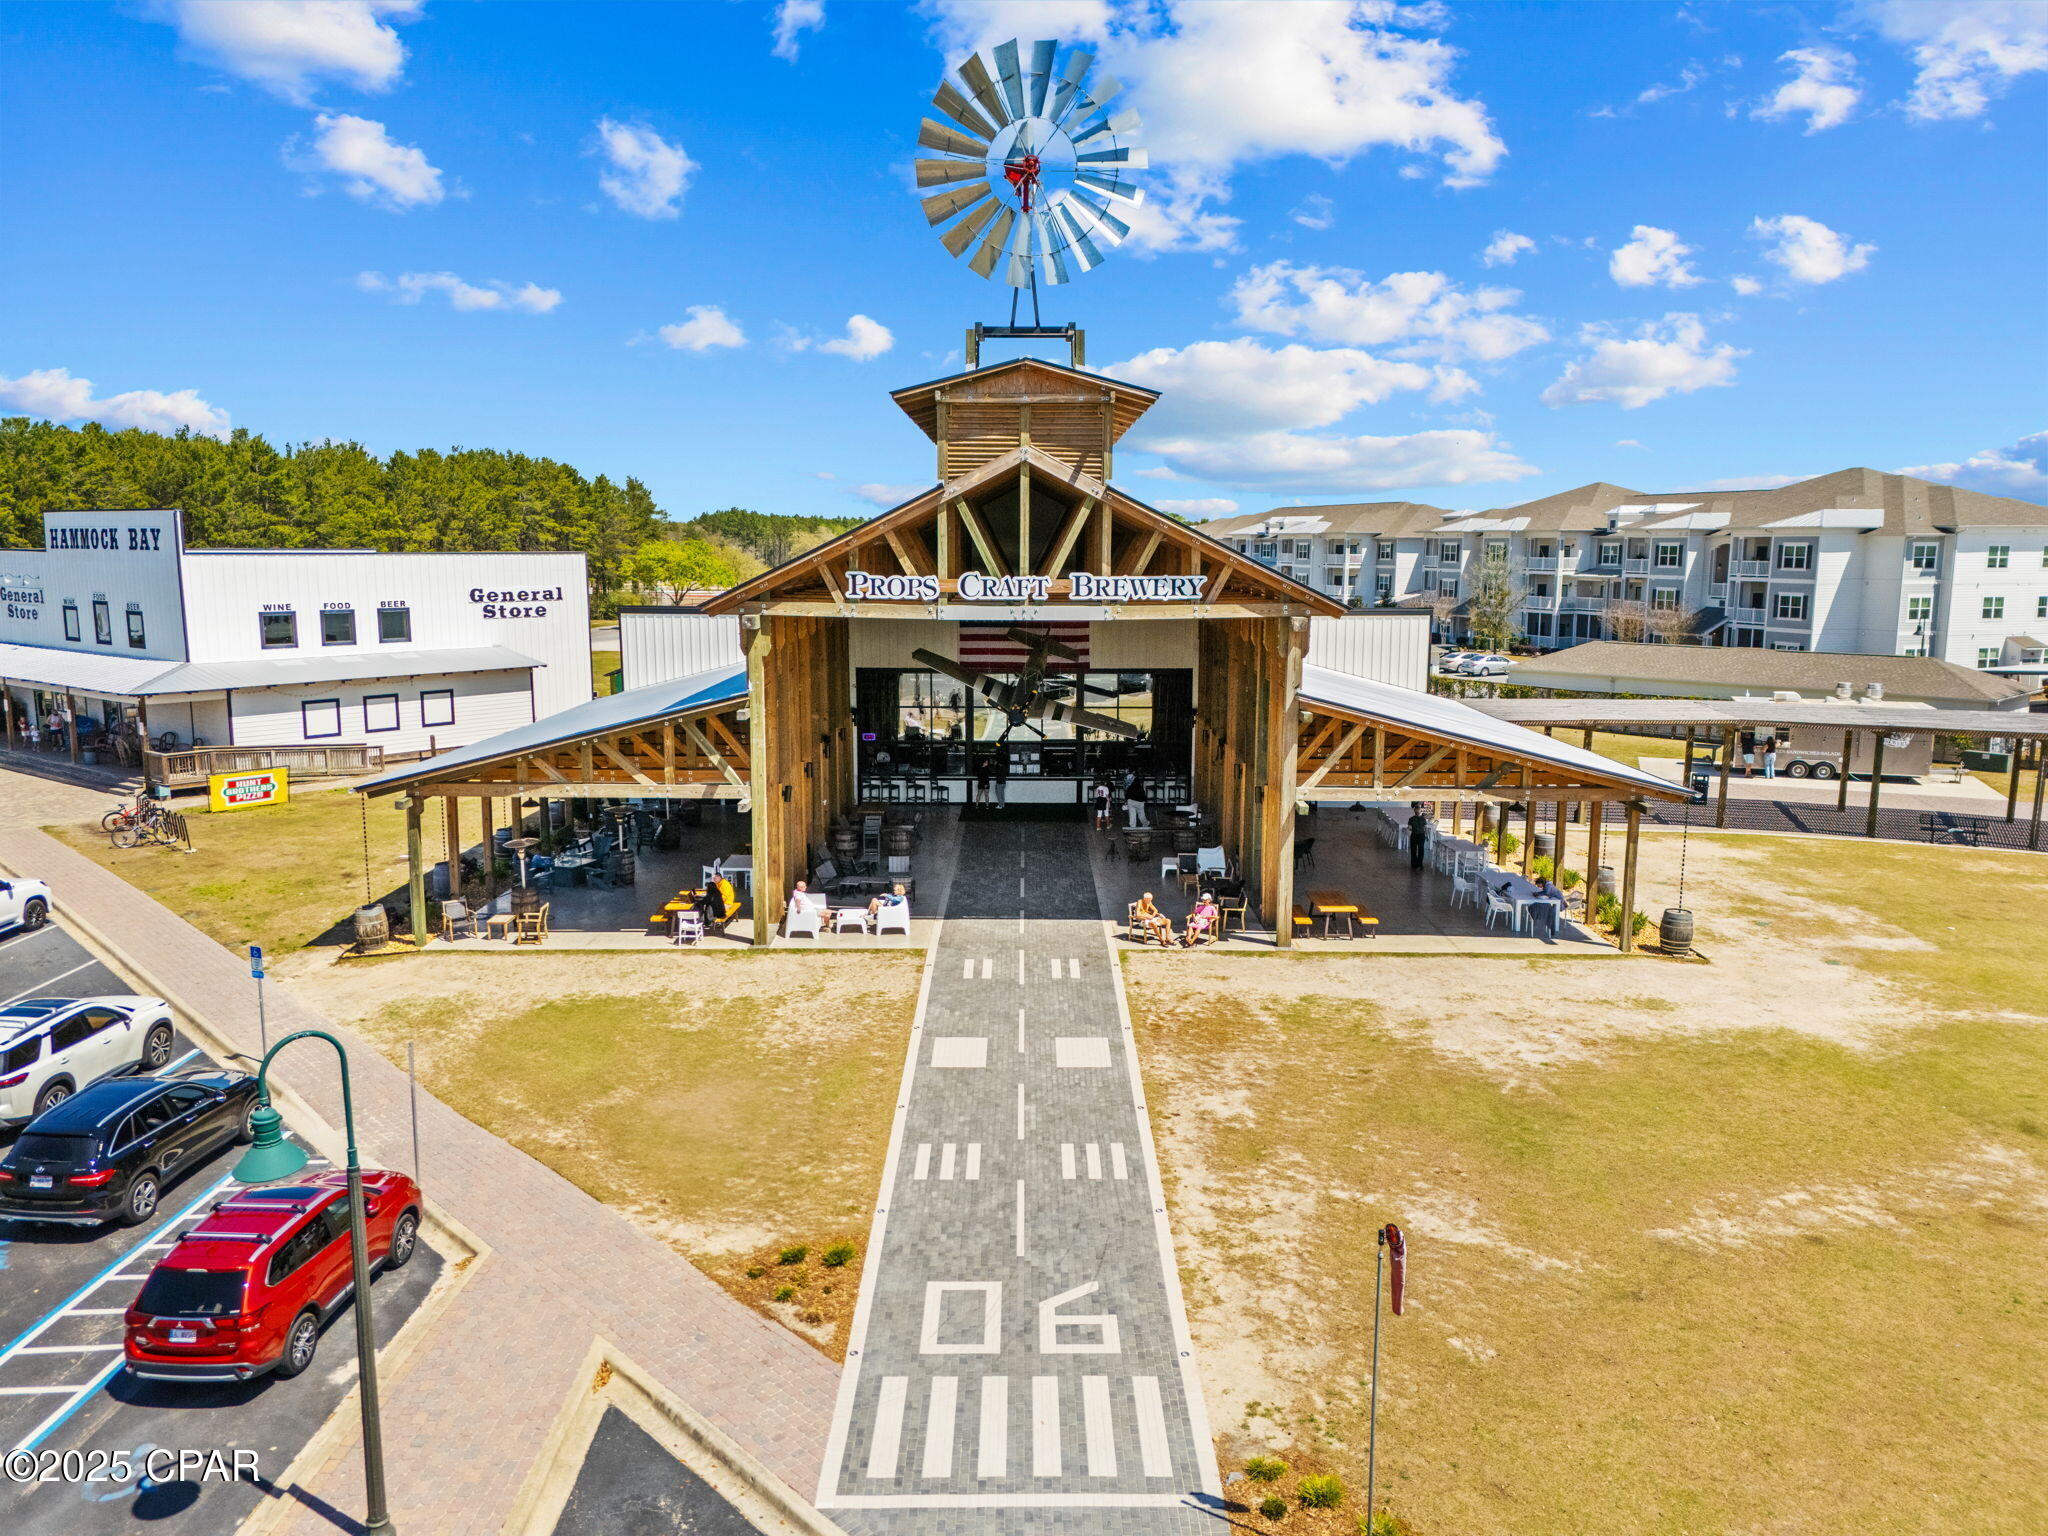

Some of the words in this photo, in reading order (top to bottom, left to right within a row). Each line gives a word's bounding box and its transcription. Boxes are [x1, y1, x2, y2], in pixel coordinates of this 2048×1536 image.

[50, 528, 119, 550] HAMMOCK
[128, 528, 161, 551] BAY
[847, 573, 939, 597] PROPS
[959, 573, 1051, 598] CRAFT
[1071, 574, 1204, 598] BREWERY
[0, 587, 44, 604] General
[92, 593, 107, 601] FOOD
[469, 586, 563, 603] General
[126, 602, 140, 611] BEER
[263, 603, 292, 611] WINE
[323, 602, 351, 610] FOOD
[380, 600, 406, 608] BEER
[7, 604, 38, 620] Store
[482, 604, 547, 619] Store
[236, 778, 262, 788] HUNT
[226, 784, 273, 796] BROTHERS
[236, 791, 264, 801] PIZZA
